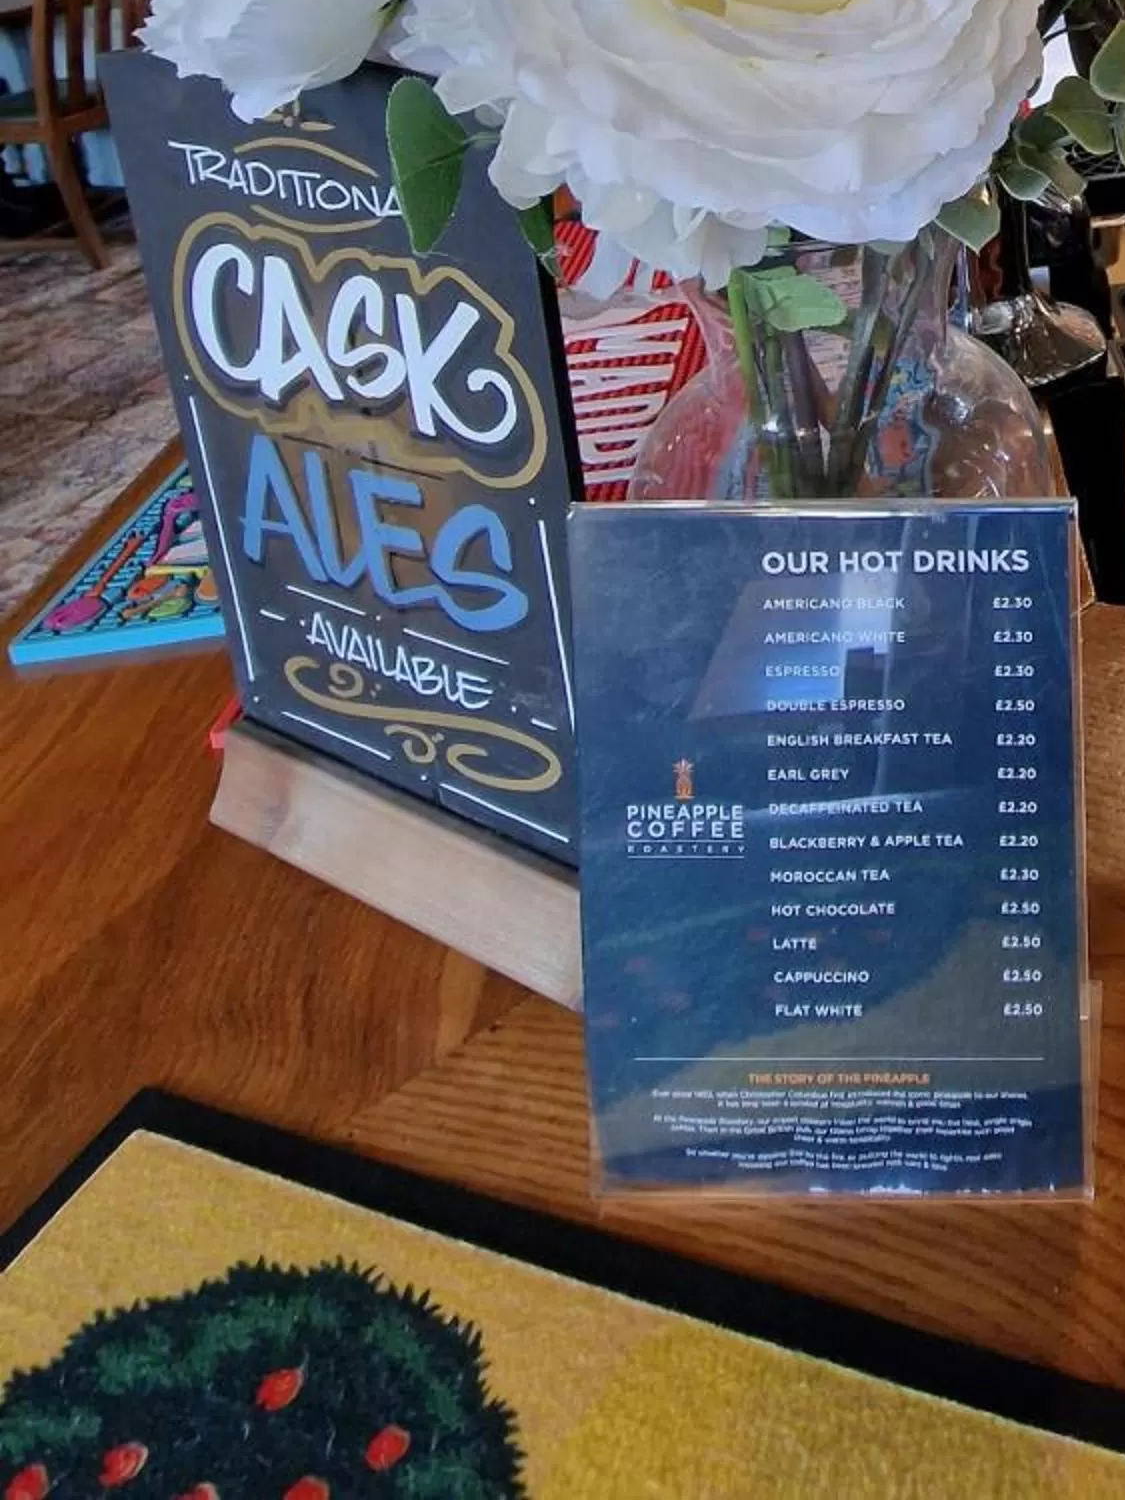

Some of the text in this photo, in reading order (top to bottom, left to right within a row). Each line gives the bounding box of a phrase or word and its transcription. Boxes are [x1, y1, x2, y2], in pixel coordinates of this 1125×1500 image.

[167, 140, 403, 217] TRADITIONA
[191, 243, 517, 444] CASK
[237, 433, 529, 632] ALES
[761, 548, 1030, 575] OUR HOT DRINKS
[763, 597, 1033, 611] AMERICANO BLACK £2.30
[764, 631, 1033, 645] AMERICANO WHITE £2.30
[305, 611, 494, 710] AVAILABLE
[765, 665, 1035, 678] ESPRESSO £2.30
[766, 699, 1035, 712] DOUBLE ESPRESSO £2.50
[767, 732, 1036, 747] ENGLISH BREAKFAST TEA £2.20
[767, 767, 1037, 781] EARL GREY £2.20
[626, 804, 744, 820] PINEAPPLE
[768, 801, 1038, 815] DECAFFEINATED TEA £2.20
[626, 820, 745, 839] COFFEE
[769, 834, 1039, 849] BLACKBERRY & APPLE TEA £2.20
[770, 869, 1040, 883] MOROCCAN TEA £2.30
[771, 902, 1041, 917] HOT CHOCOLATE £2.50
[772, 936, 1042, 950] LATTE £2.50
[773, 969, 1043, 984] CAPPUCCINO £2.50
[775, 1003, 1043, 1017] FLAT WHITE £2.50
